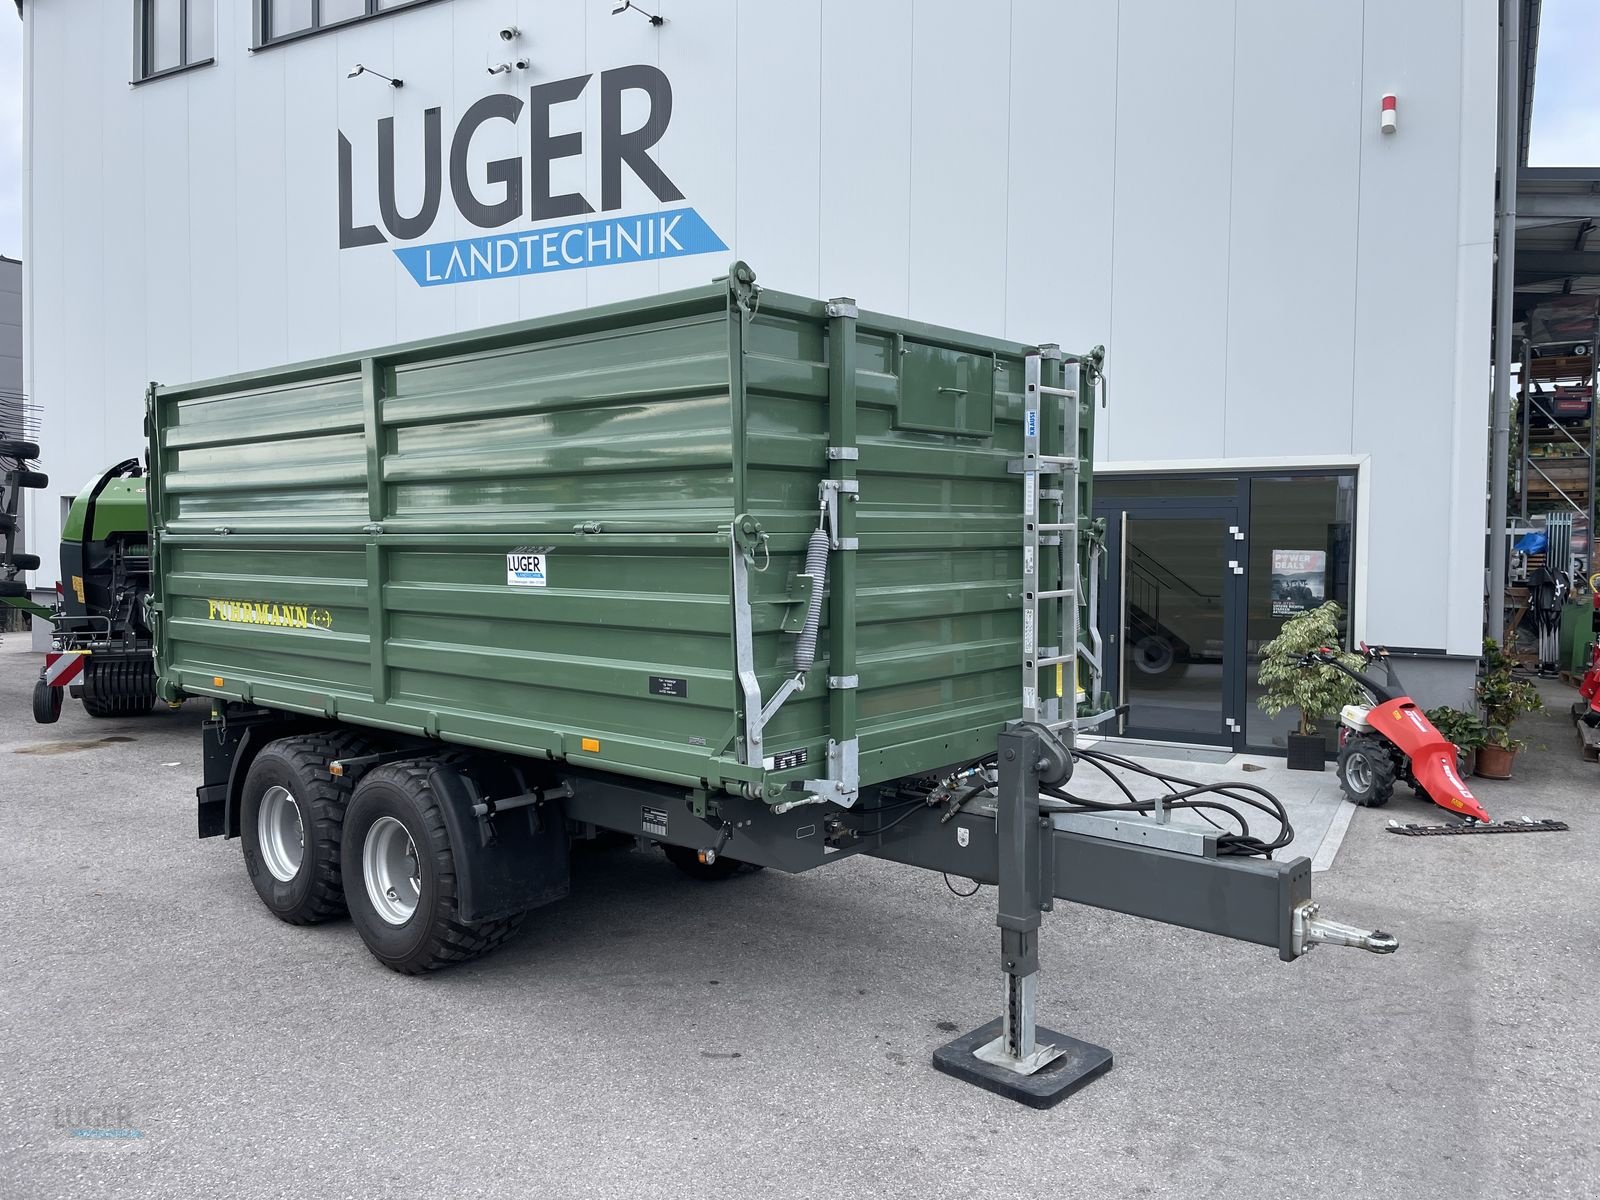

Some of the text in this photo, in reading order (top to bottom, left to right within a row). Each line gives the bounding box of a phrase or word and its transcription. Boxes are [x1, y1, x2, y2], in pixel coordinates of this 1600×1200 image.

[338, 64, 687, 249] LUGER
[424, 214, 685, 283] LANDTECHNIK
[508, 556, 541, 572] LUGER
[208, 599, 307, 628] FUHRMANN
